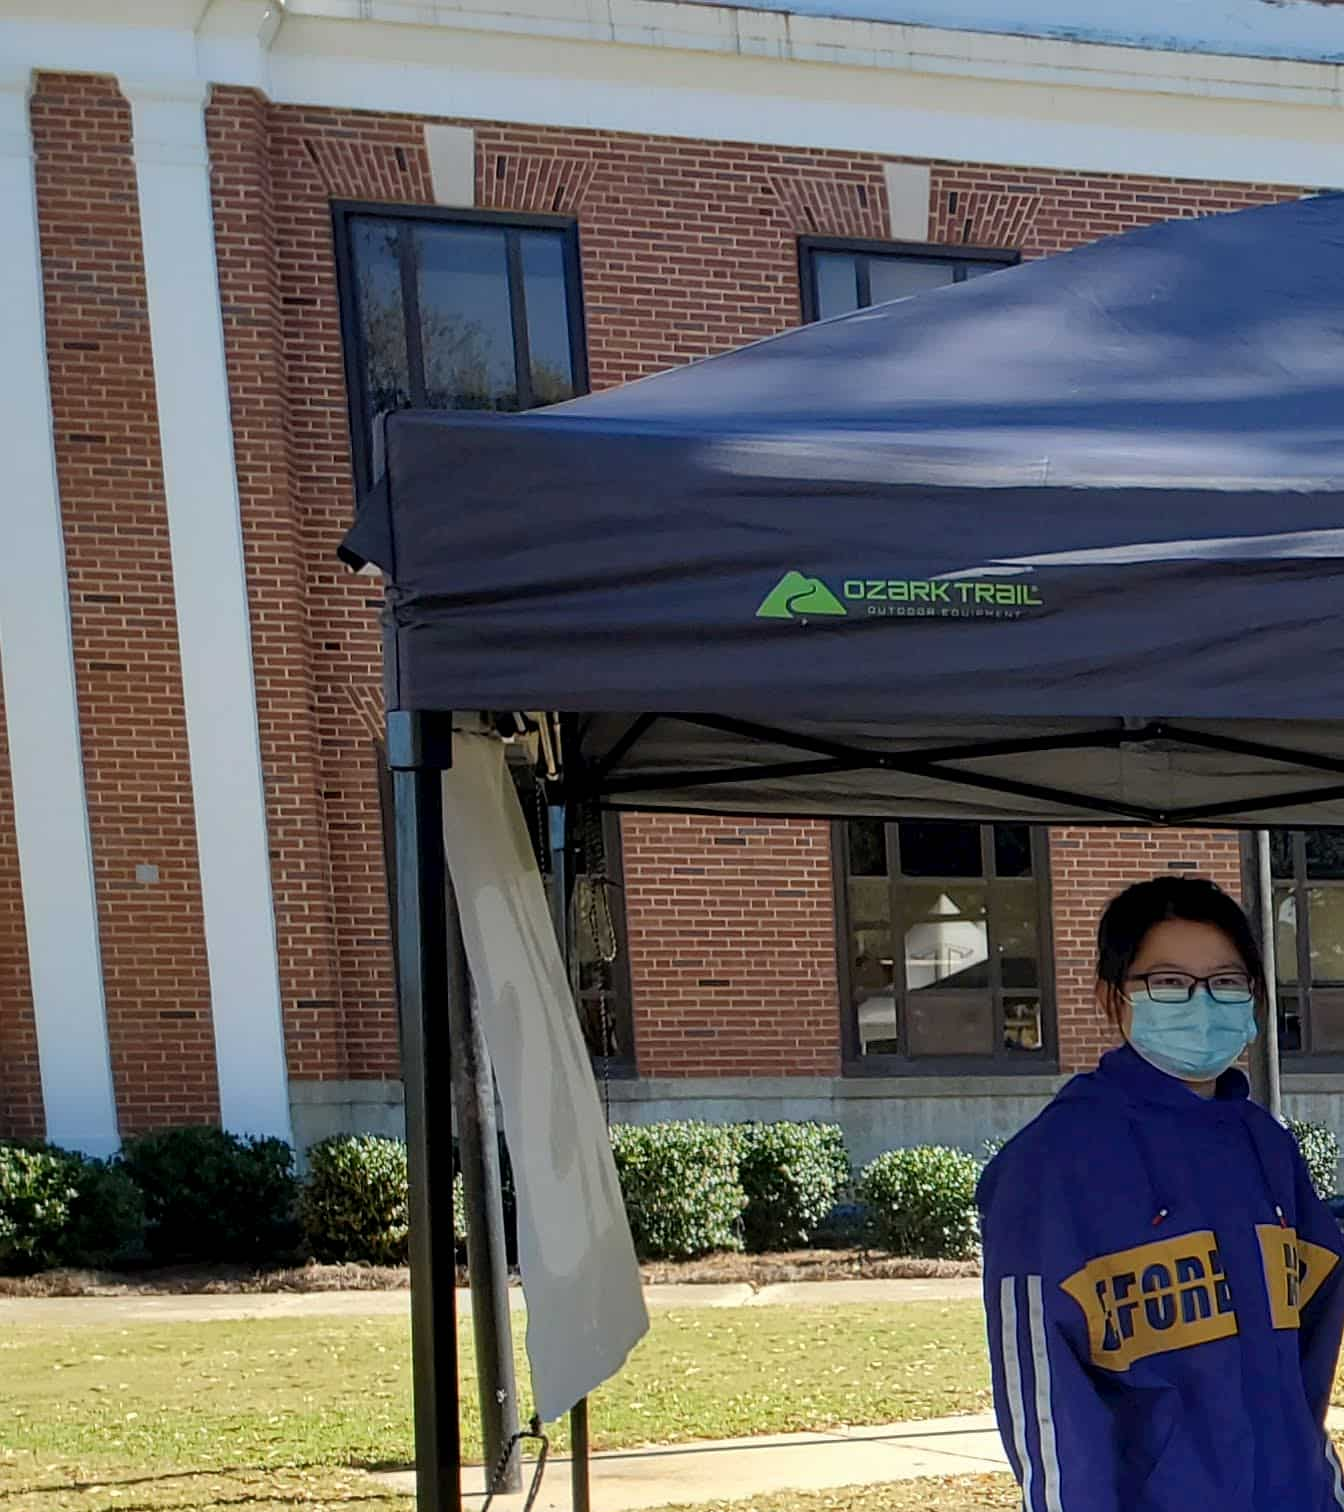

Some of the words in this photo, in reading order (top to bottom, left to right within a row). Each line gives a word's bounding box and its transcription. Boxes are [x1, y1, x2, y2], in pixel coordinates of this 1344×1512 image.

[843, 580, 951, 602] OZARK
[954, 583, 1043, 606] TRAIL
[867, 606, 936, 617] OUTDOOR
[941, 607, 1022, 619] EQUIPMENT
